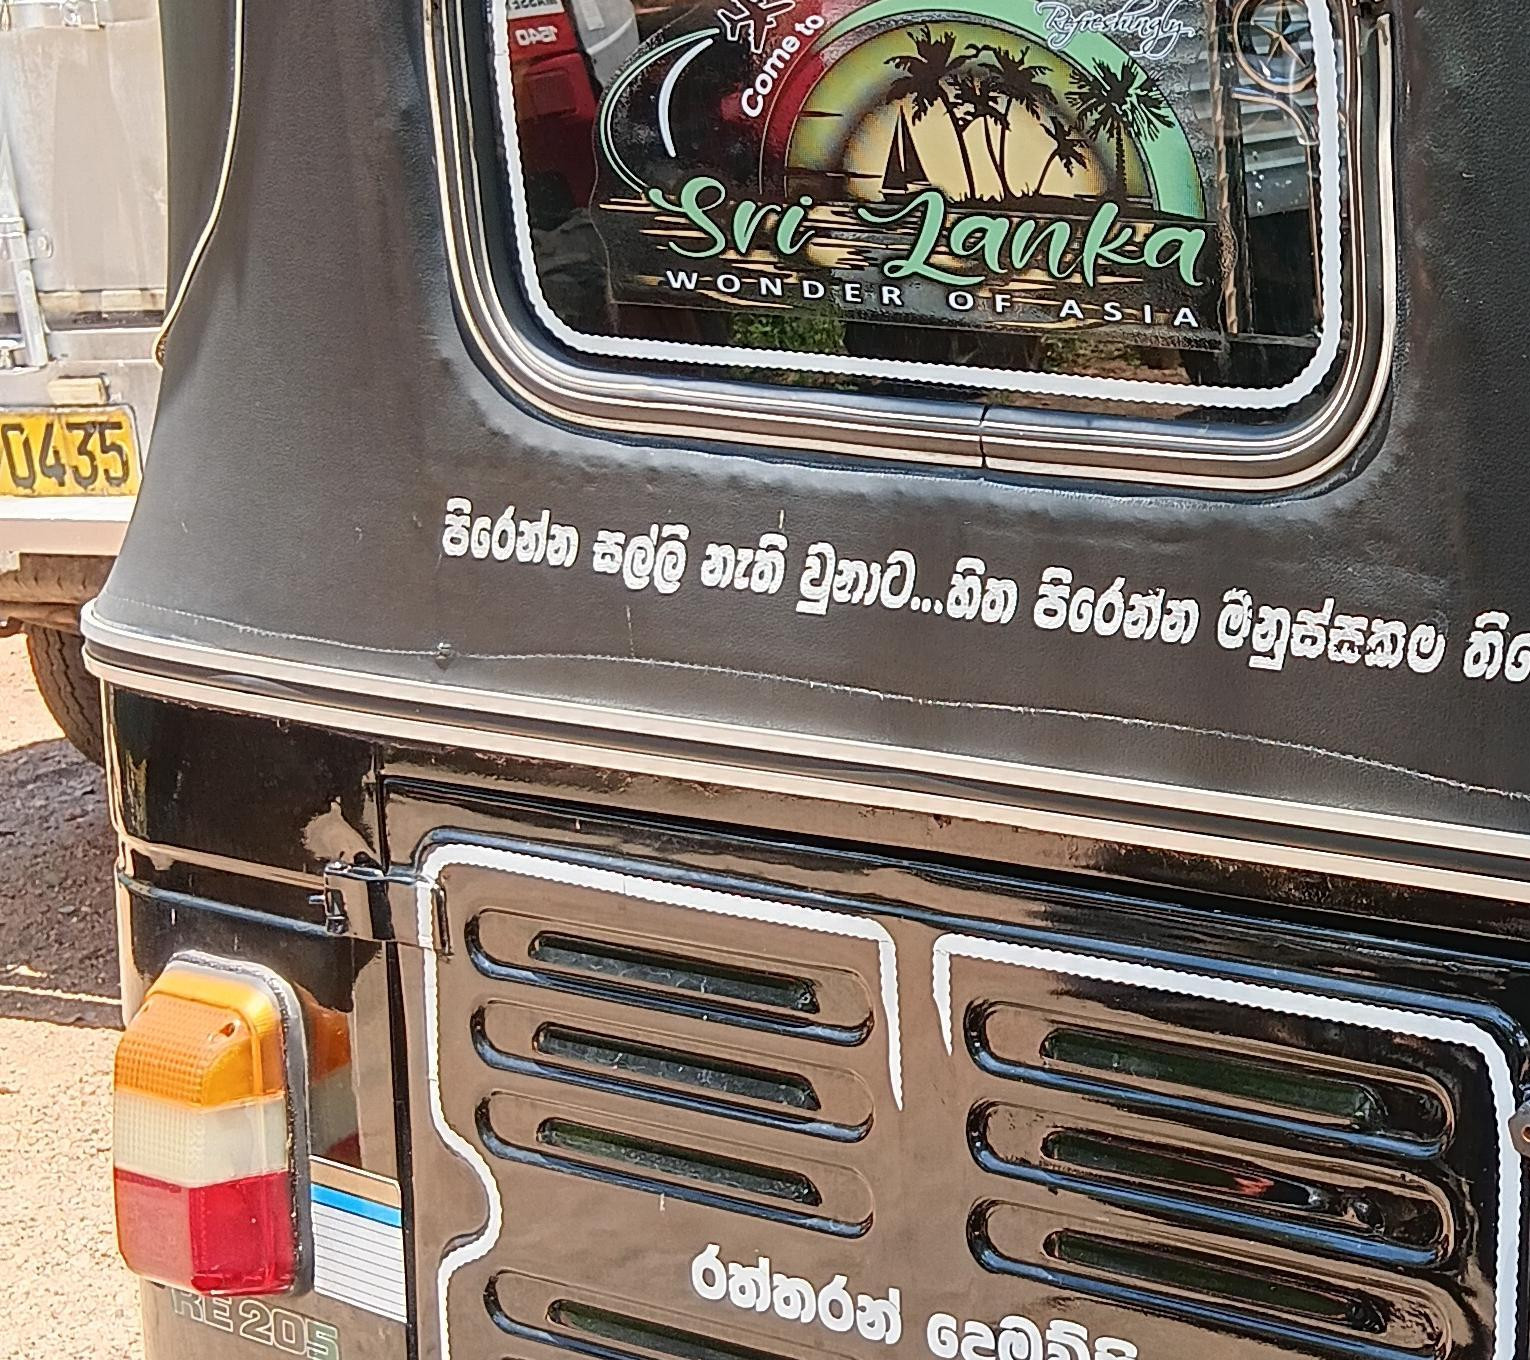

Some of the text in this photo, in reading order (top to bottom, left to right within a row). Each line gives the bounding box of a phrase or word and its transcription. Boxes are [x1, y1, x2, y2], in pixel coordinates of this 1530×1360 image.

[741, 15, 825, 117] Come to
[648, 176, 1204, 288] Sri Lanka
[665, 269, 1200, 328] WONDER OF ASIA
[592, 523, 690, 595] සල්ලි
[700, 533, 788, 594] නැති
[691, 1243, 902, 1345] රත්තරන්
